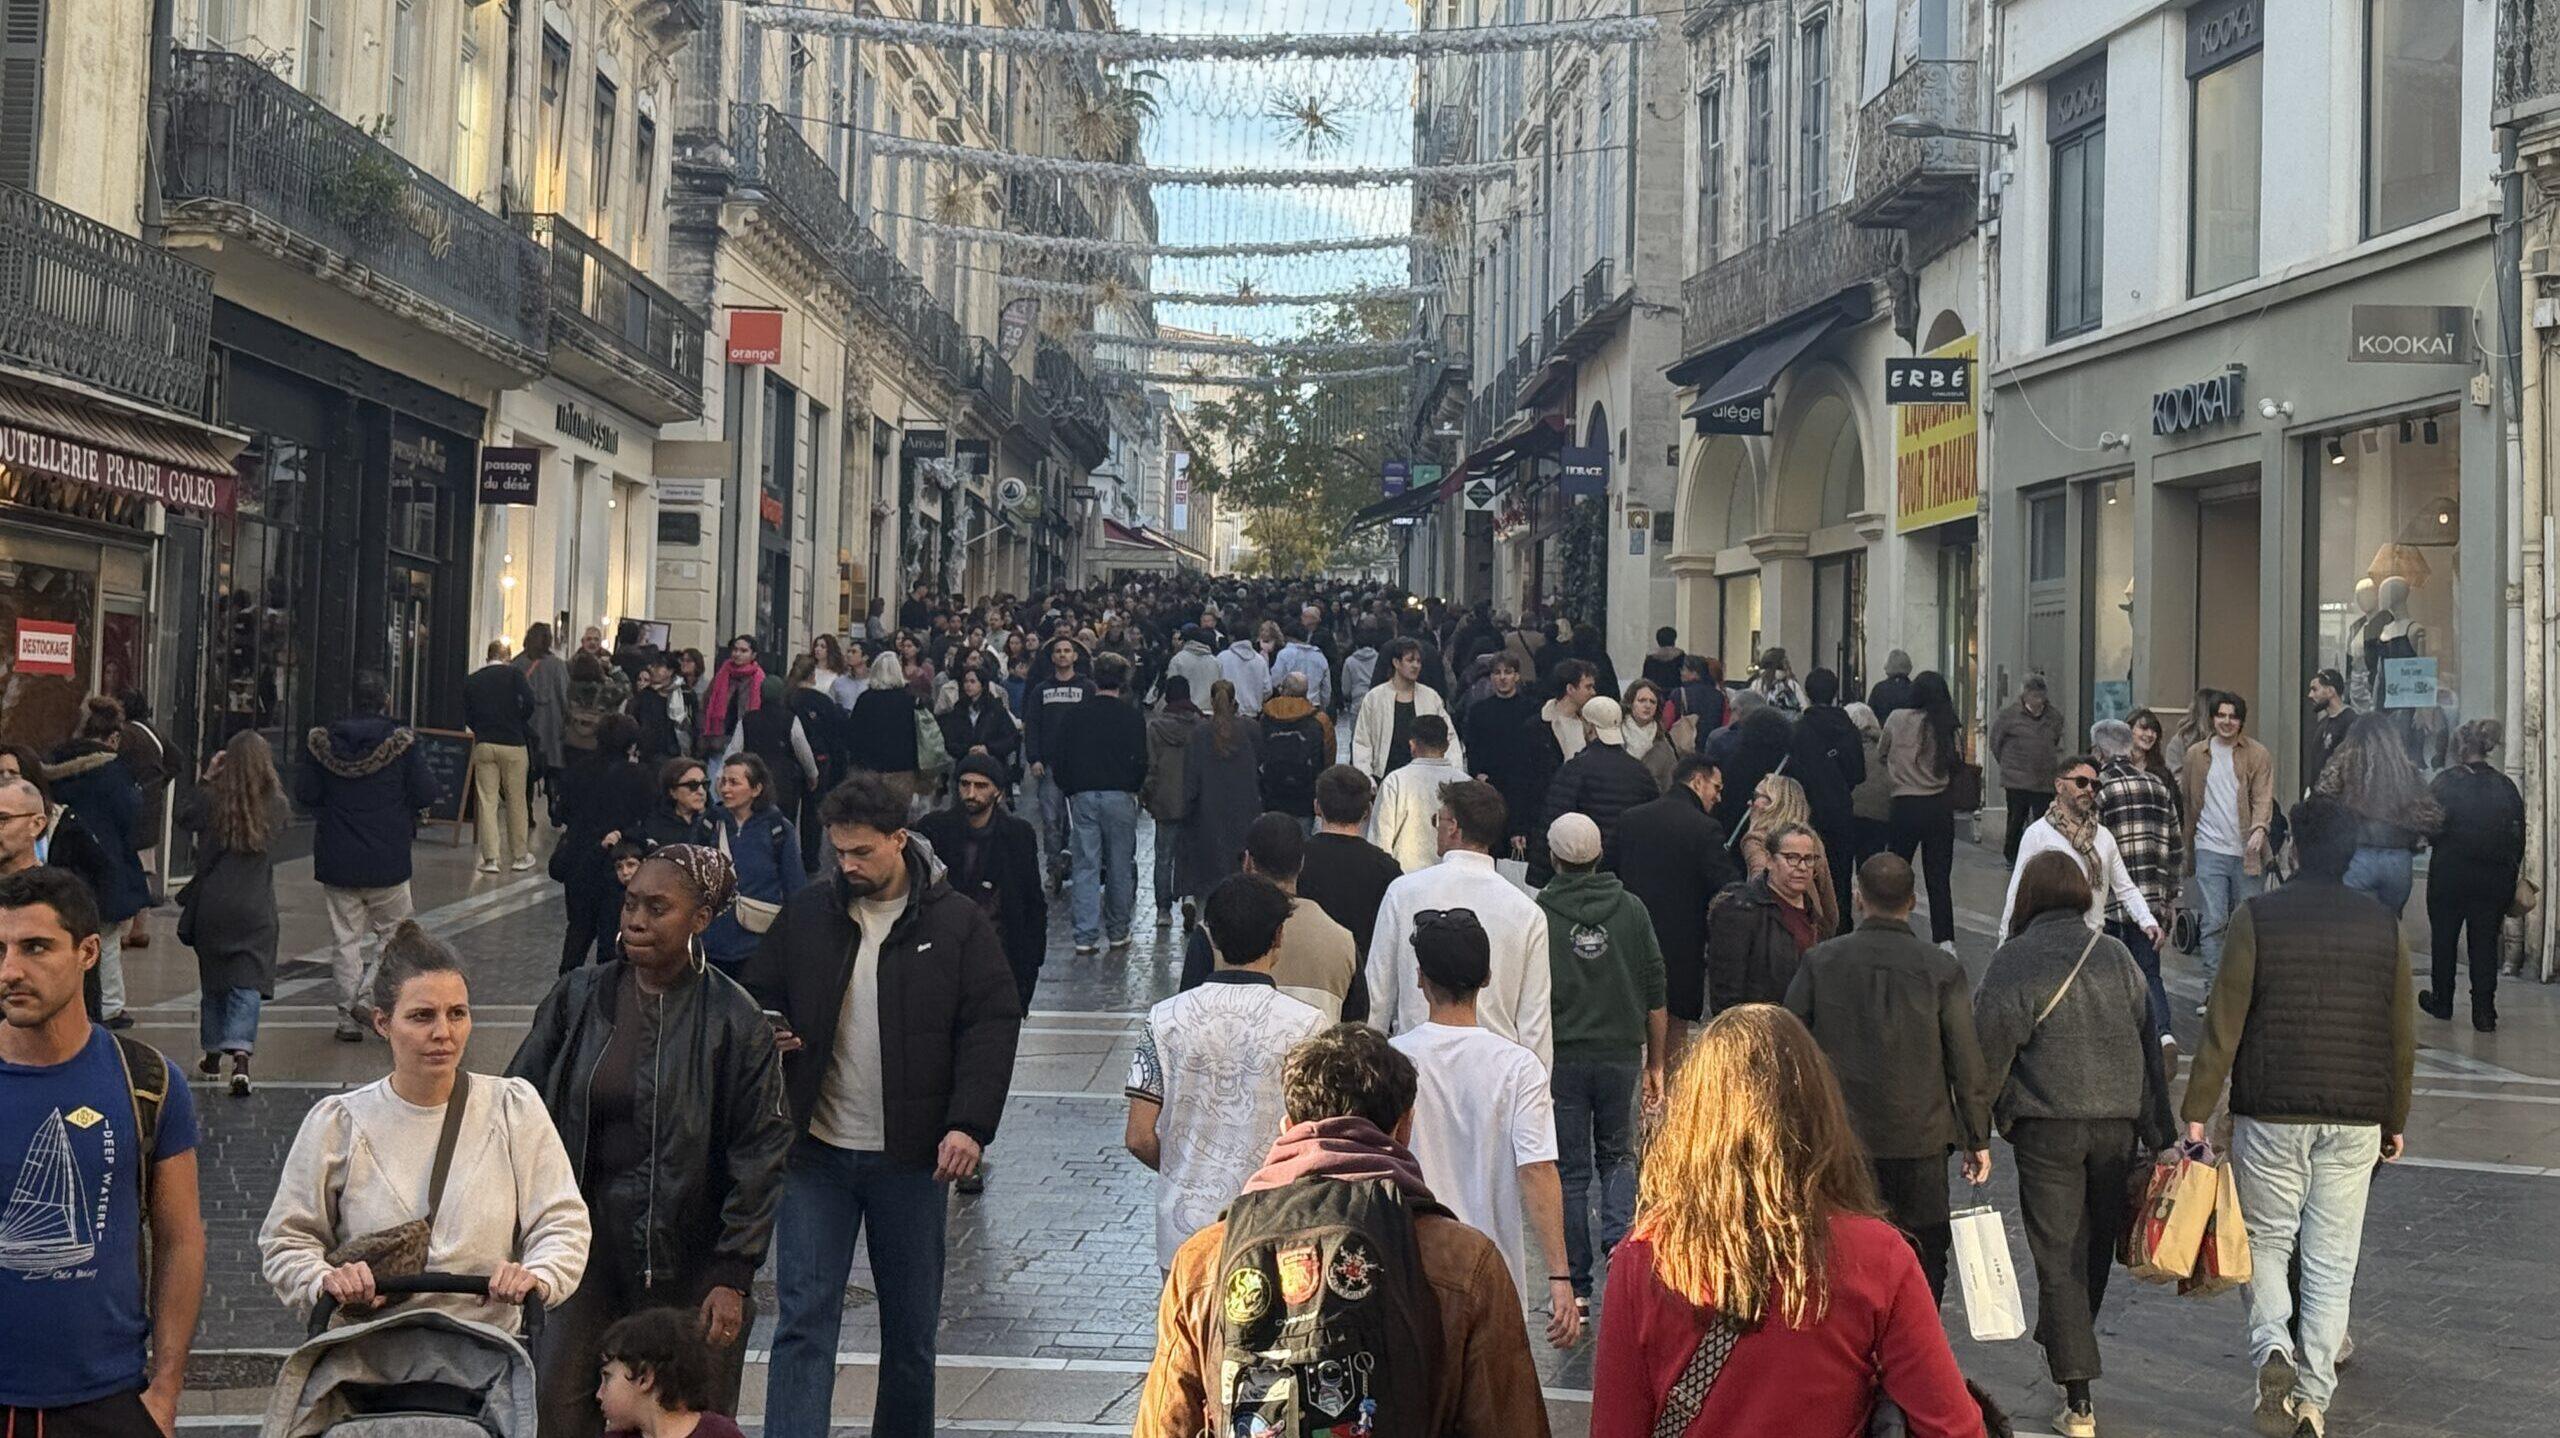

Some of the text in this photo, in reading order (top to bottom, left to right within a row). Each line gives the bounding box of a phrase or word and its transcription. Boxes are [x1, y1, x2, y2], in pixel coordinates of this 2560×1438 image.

[2359, 333, 2454, 355] KOOKAÏ
[731, 349, 775, 362] orange
[1890, 366, 1965, 387] ERBÉ
[485, 461, 532, 475] passage
[1566, 466, 1602, 476] HORACE
[1897, 430, 1979, 518] POUR TRAVAUX
[106, 453, 164, 498] PRADEL
[169, 470, 216, 509] GOLEO
[484, 476, 532, 491] du désir
[22, 638, 69, 656] DESTOCKAGE
[96, 1130, 115, 1229] DEEP WATERS
